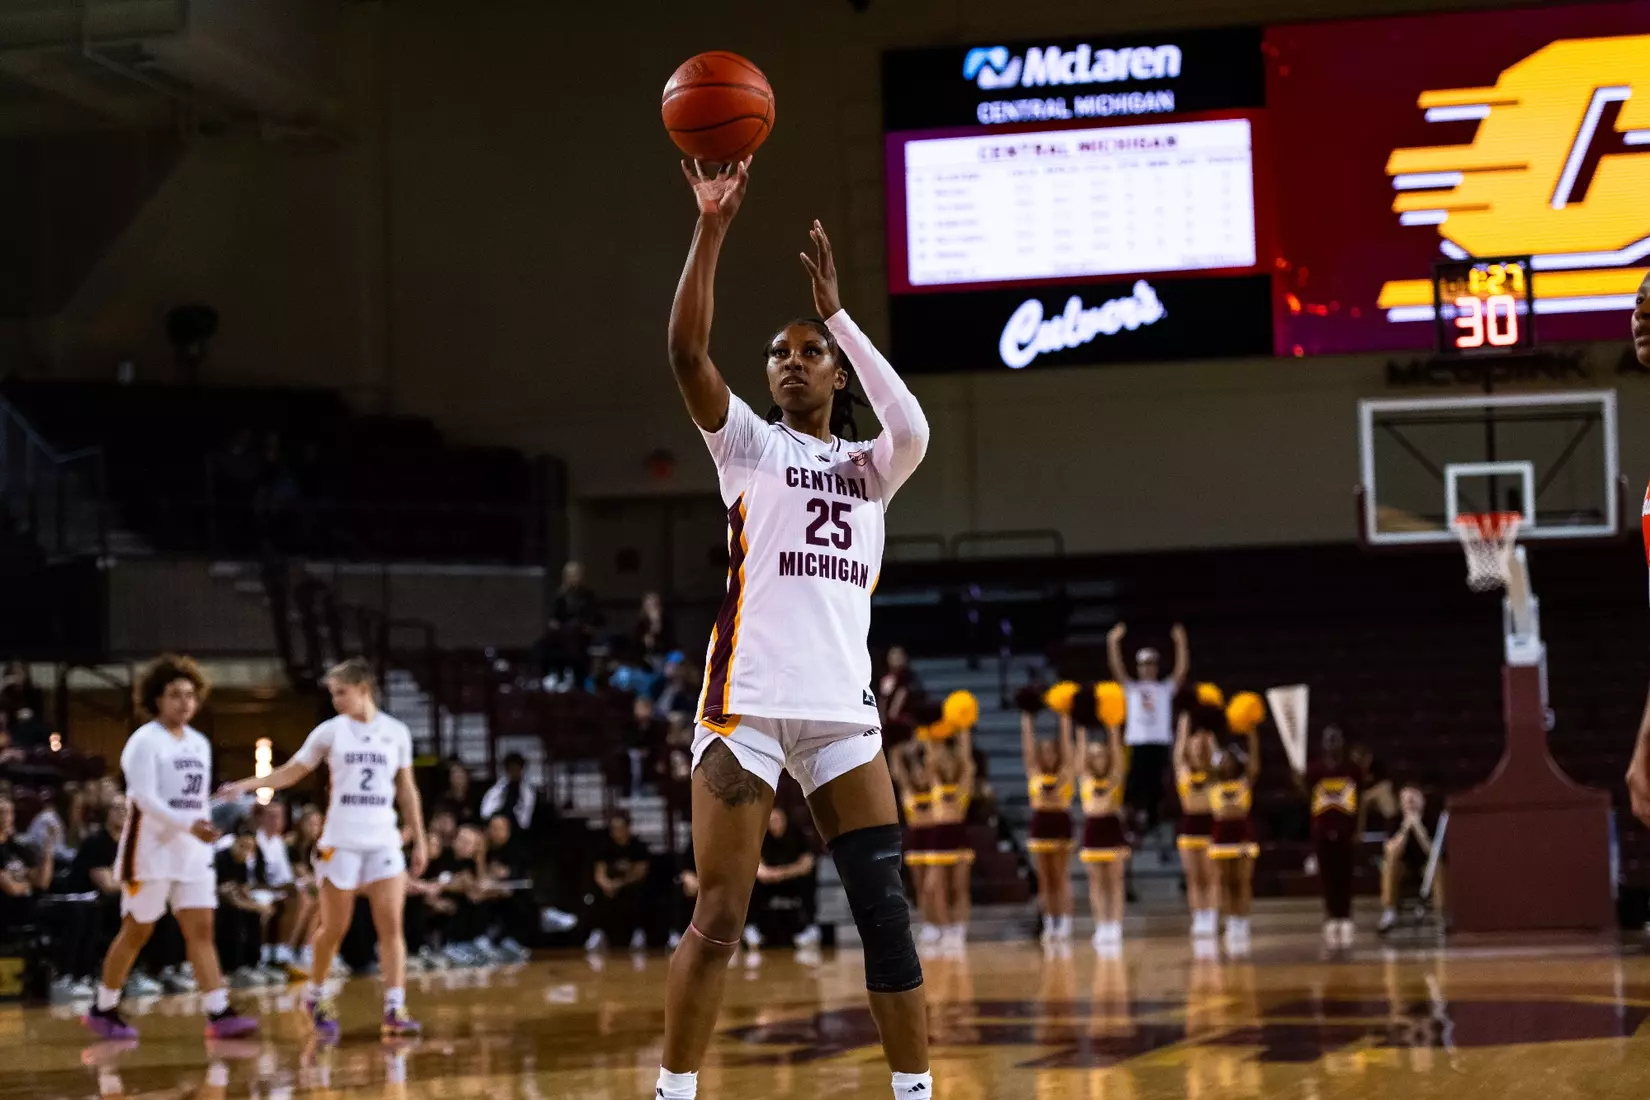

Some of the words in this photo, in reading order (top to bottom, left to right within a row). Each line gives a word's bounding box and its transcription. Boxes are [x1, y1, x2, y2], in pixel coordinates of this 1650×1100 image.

[1021, 44, 1182, 87] McLaren
[977, 97, 1073, 124] CENTRAL
[1074, 90, 1175, 118] MICHIGAN
[1469, 263, 1524, 294] 1:27
[1455, 295, 1518, 348] 30
[786, 466, 868, 501] CENTRAL
[806, 498, 852, 550] 25
[779, 552, 868, 589] MICHIGAN
[361, 768, 373, 791] 2
